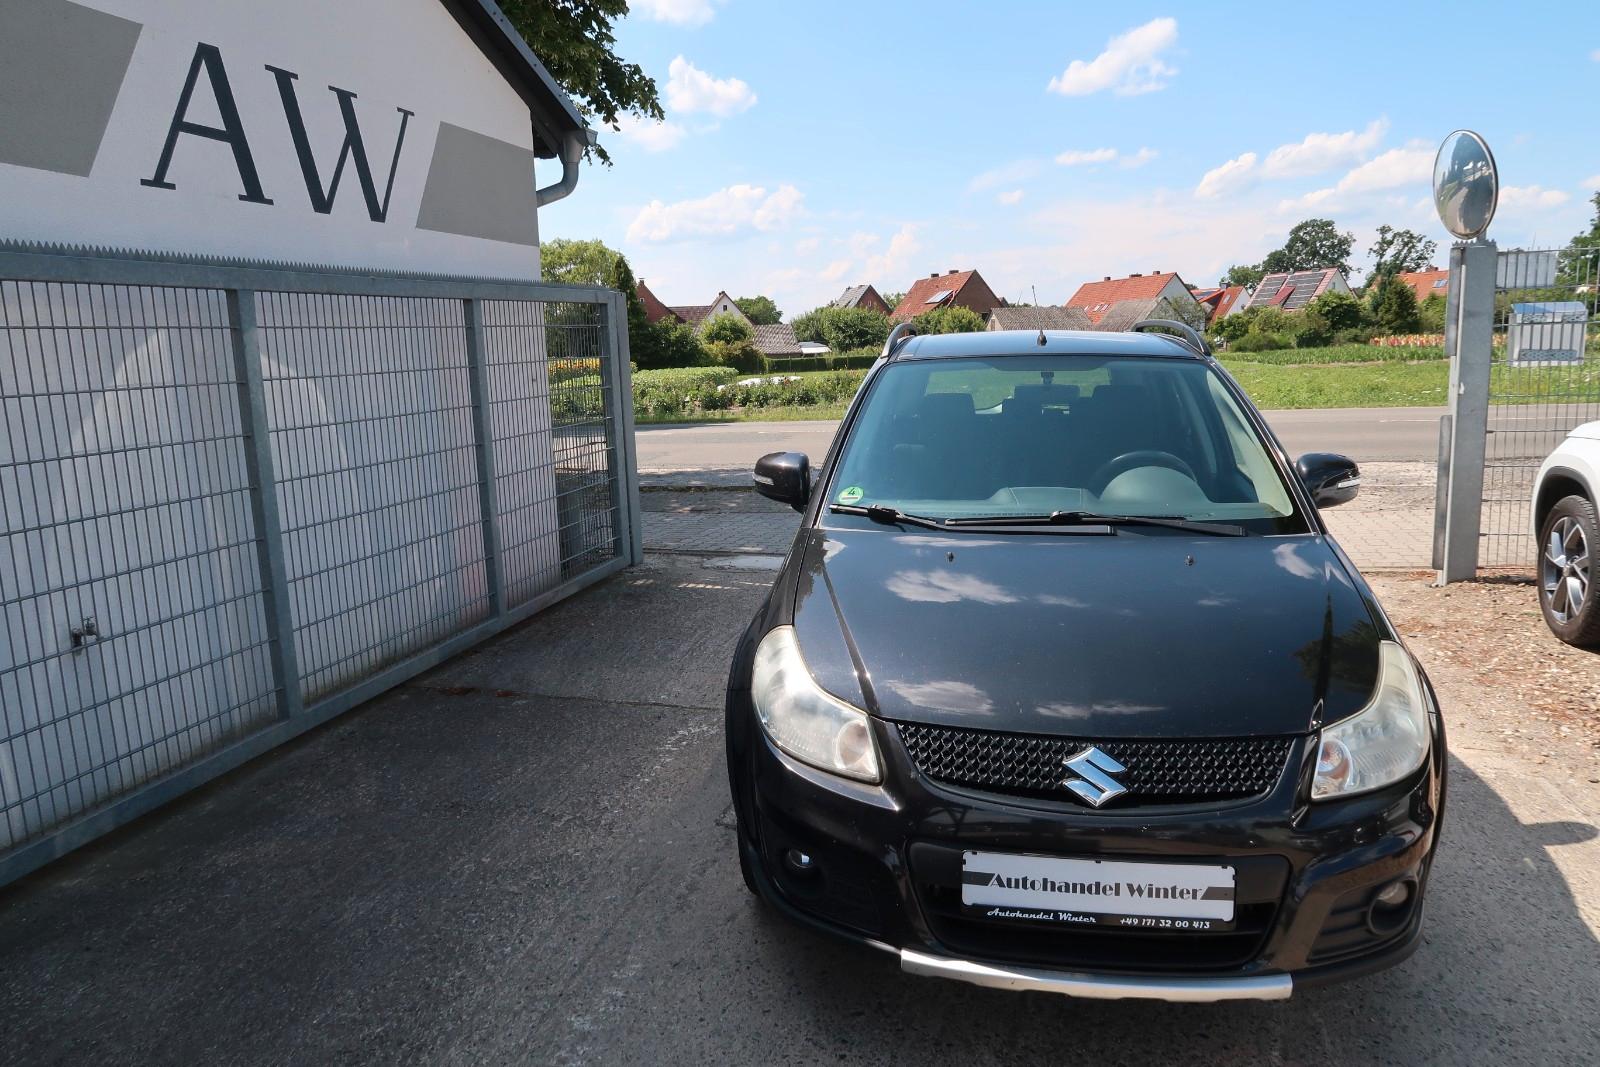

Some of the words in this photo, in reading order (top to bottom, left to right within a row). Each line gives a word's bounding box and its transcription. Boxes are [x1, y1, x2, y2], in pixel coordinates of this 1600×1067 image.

[140, 41, 415, 223] AW
[848, 487, 856, 496] 4
[990, 873, 1121, 897] Autohandel
[1126, 883, 1202, 900] Winter
[987, 907, 1054, 920] Autohandel
[1058, 911, 1096, 923] Winter
[1120, 917, 1138, 926] +49
[1141, 918, 1156, 927] 171
[1159, 919, 1171, 927] 32
[1175, 920, 1189, 928] 00
[1192, 920, 1210, 929] 413
